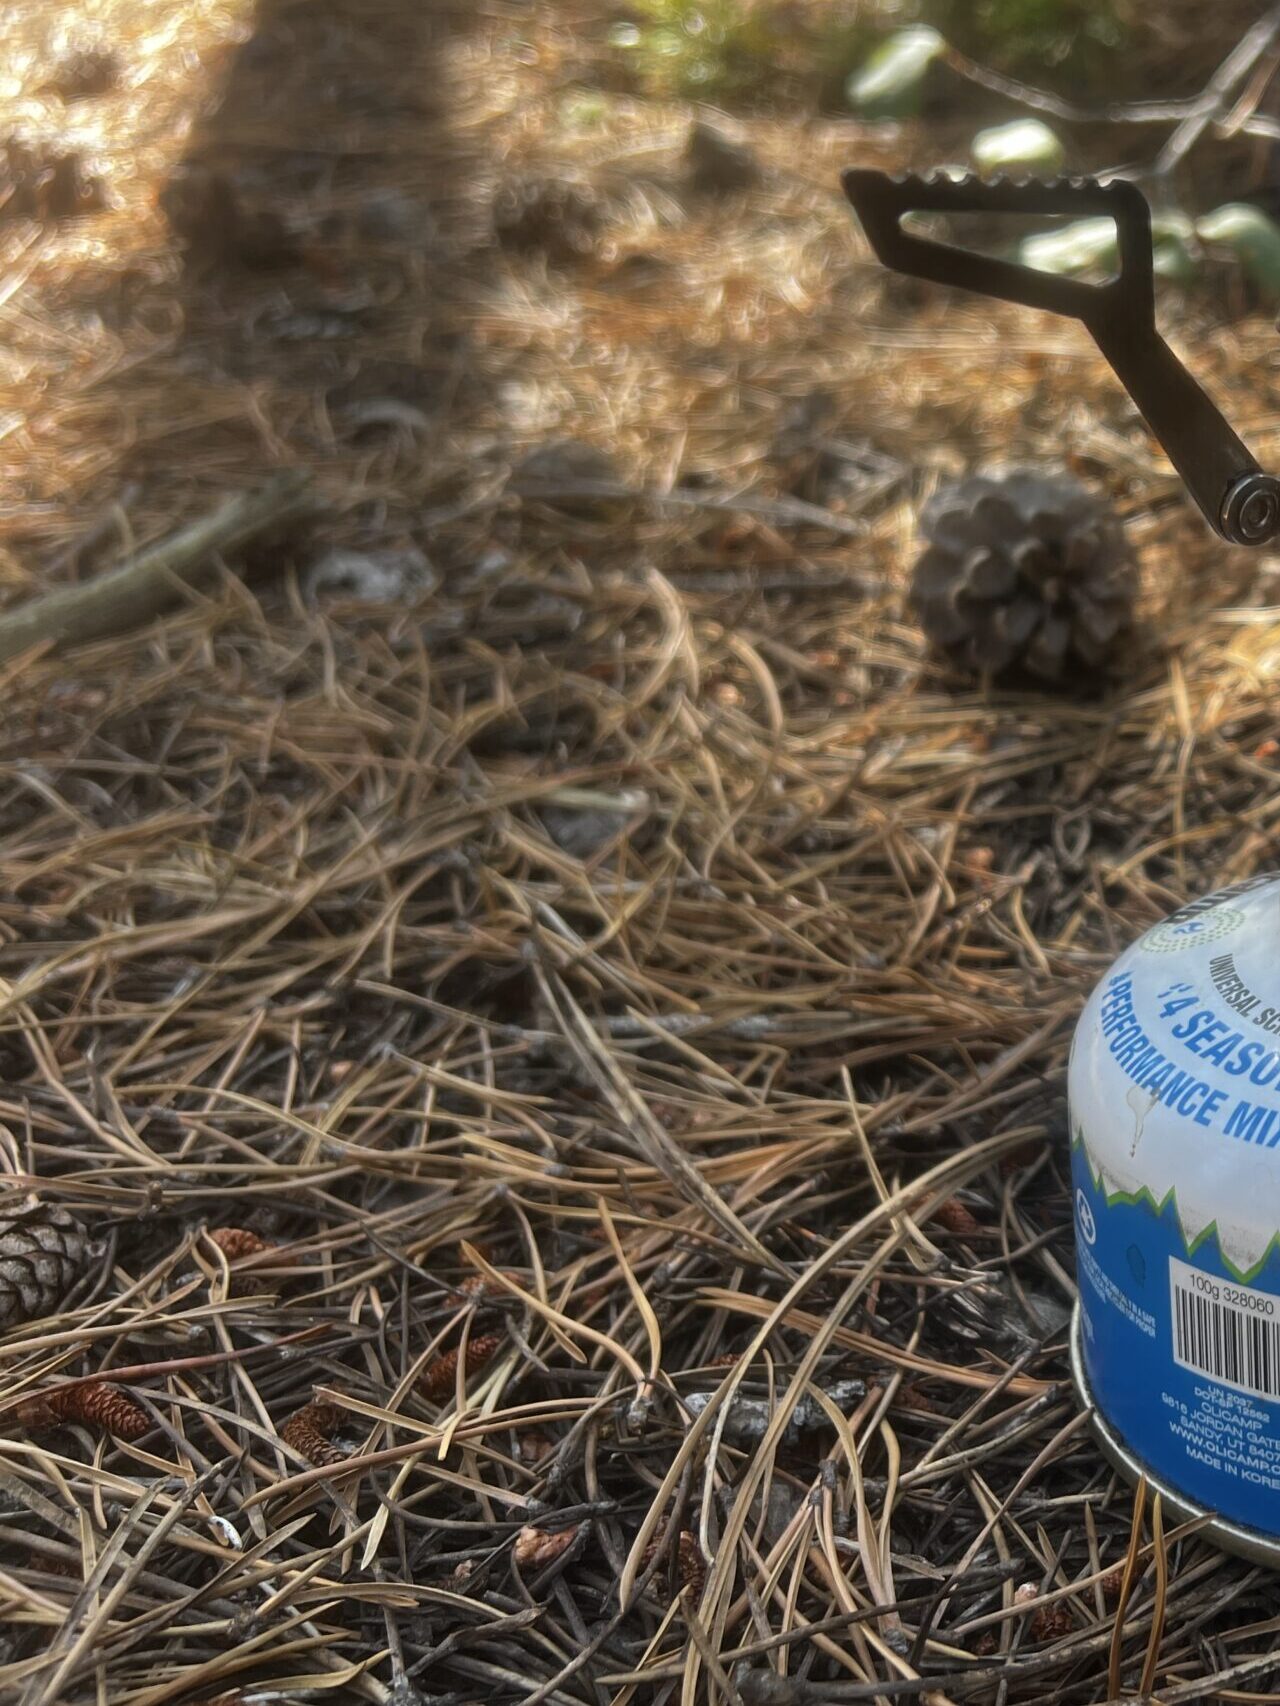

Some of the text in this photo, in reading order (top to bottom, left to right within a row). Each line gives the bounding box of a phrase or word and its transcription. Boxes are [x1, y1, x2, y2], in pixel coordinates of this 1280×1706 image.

[1209, 952, 1262, 1018] UNIVERSAL
[1158, 992, 1199, 1020] 4
[1100, 978, 1231, 1128] PERFORMANCE
[1189, 1272, 1275, 1316] 100g 328060
[1207, 1384, 1225, 1399] UN
[1190, 1409, 1244, 1438] JORDAN
[1200, 1401, 1263, 1431] OLICAMP
[1180, 1416, 1225, 1445] SANDY,
[1227, 1436, 1246, 1450] UT
[1185, 1444, 1222, 1471] MADE
[1224, 1461, 1238, 1476] IN
